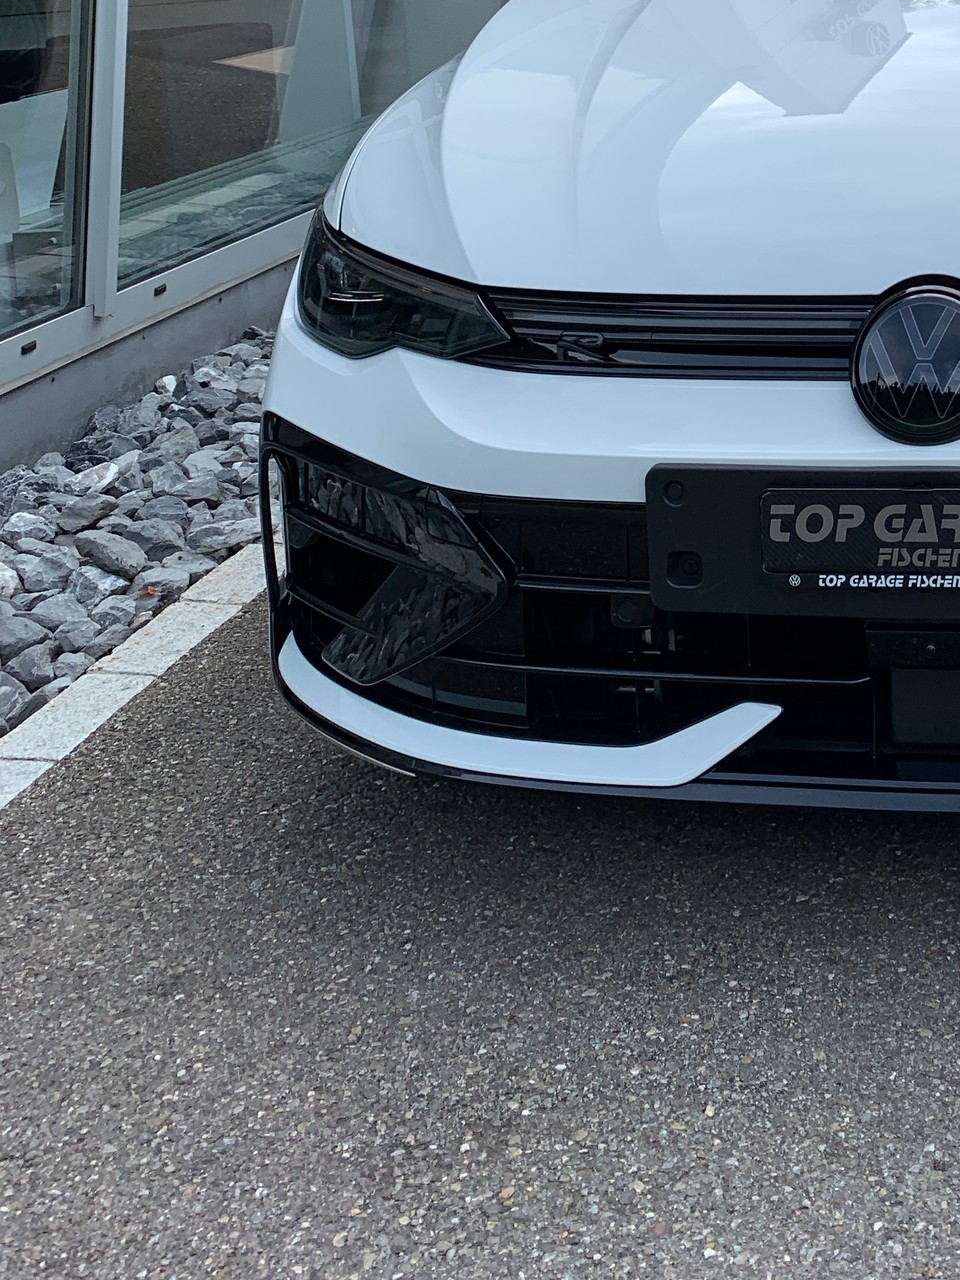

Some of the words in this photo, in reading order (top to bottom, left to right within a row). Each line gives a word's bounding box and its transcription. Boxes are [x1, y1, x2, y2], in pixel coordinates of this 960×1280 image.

[769, 504, 866, 543] TOP
[818, 575, 847, 587] TOP
[849, 575, 905, 588] GARAGE
